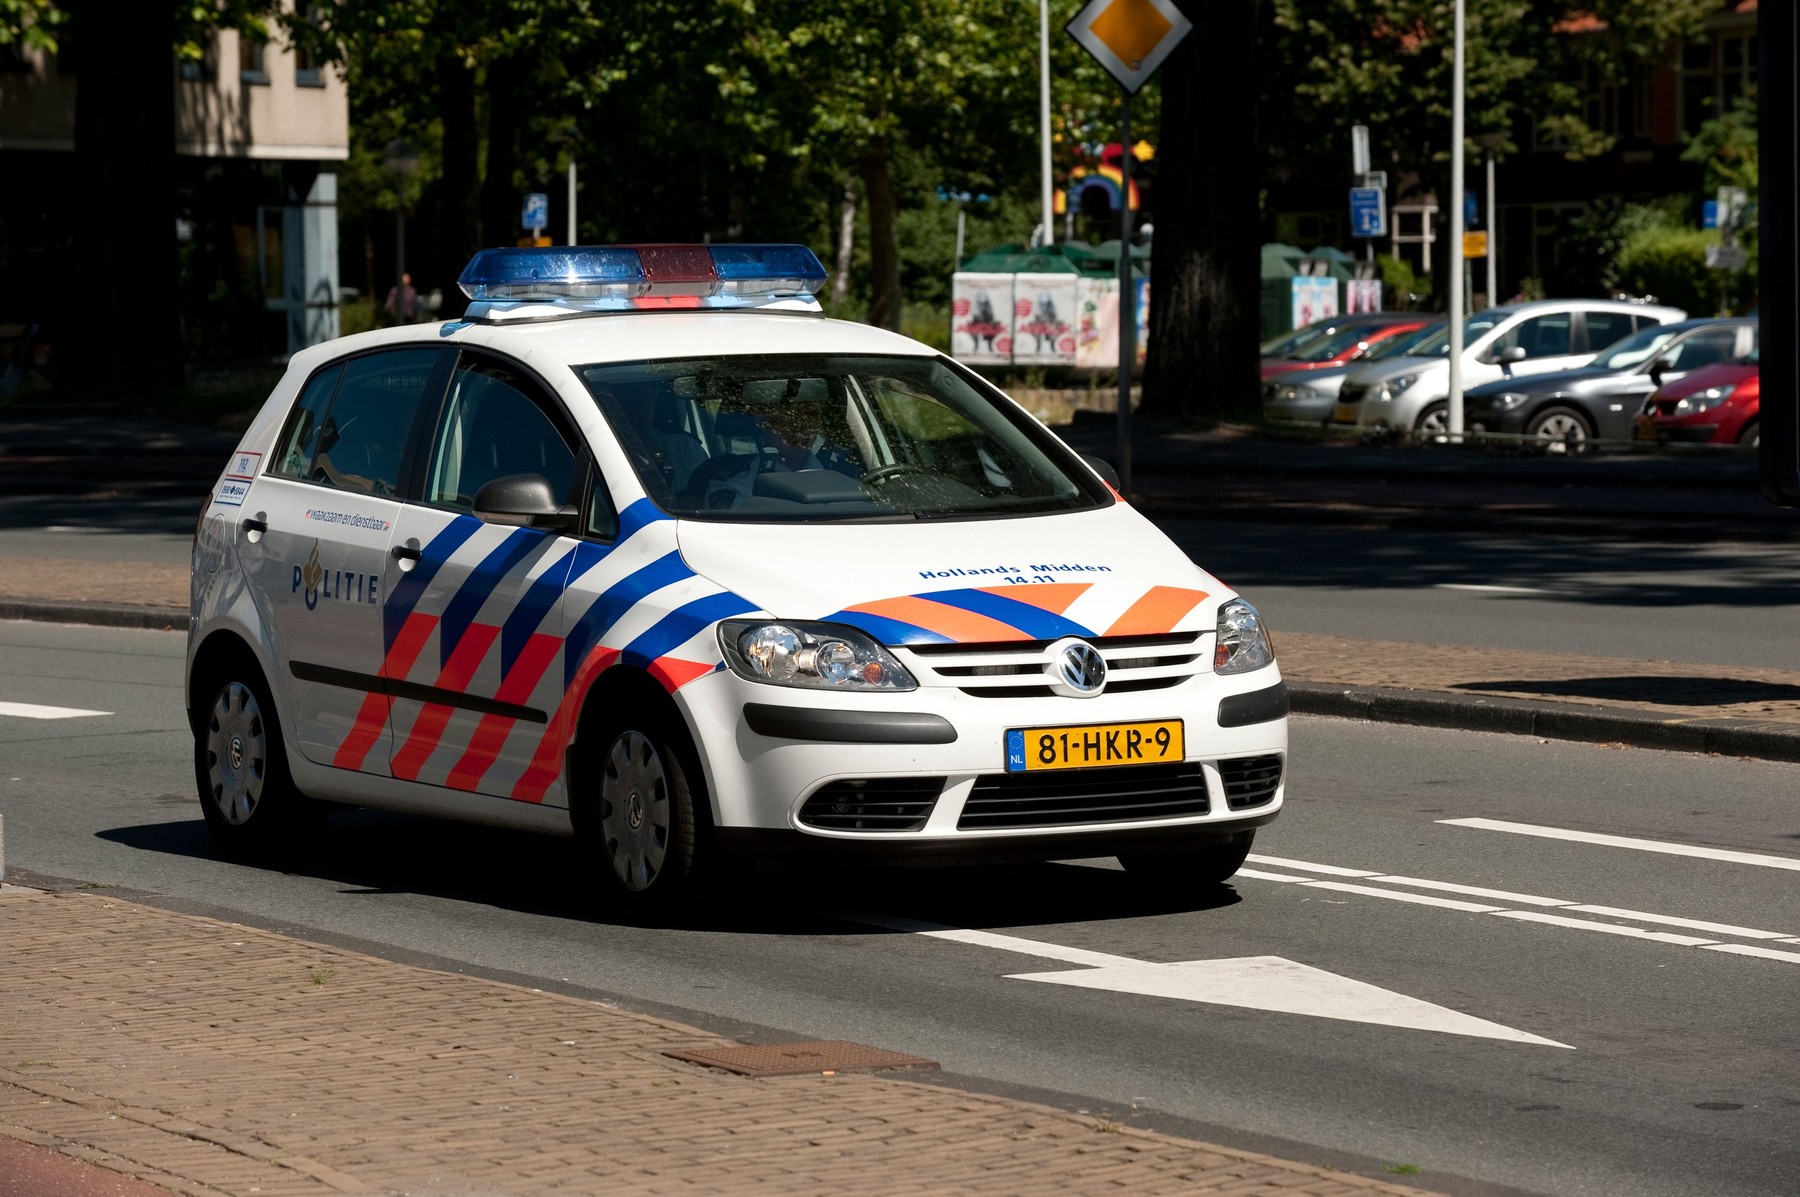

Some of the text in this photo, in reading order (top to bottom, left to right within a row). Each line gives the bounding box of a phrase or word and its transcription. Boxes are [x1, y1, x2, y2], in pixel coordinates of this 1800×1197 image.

[239, 457, 249, 469] 112
[342, 514, 351, 525] en
[918, 563, 1112, 579] Hollands Midden
[1004, 575, 1056, 585] 14.11
[292, 564, 378, 610] POLITIE
[1039, 727, 1171, 765] 81-HKR-9
[1010, 754, 1024, 765] NL
